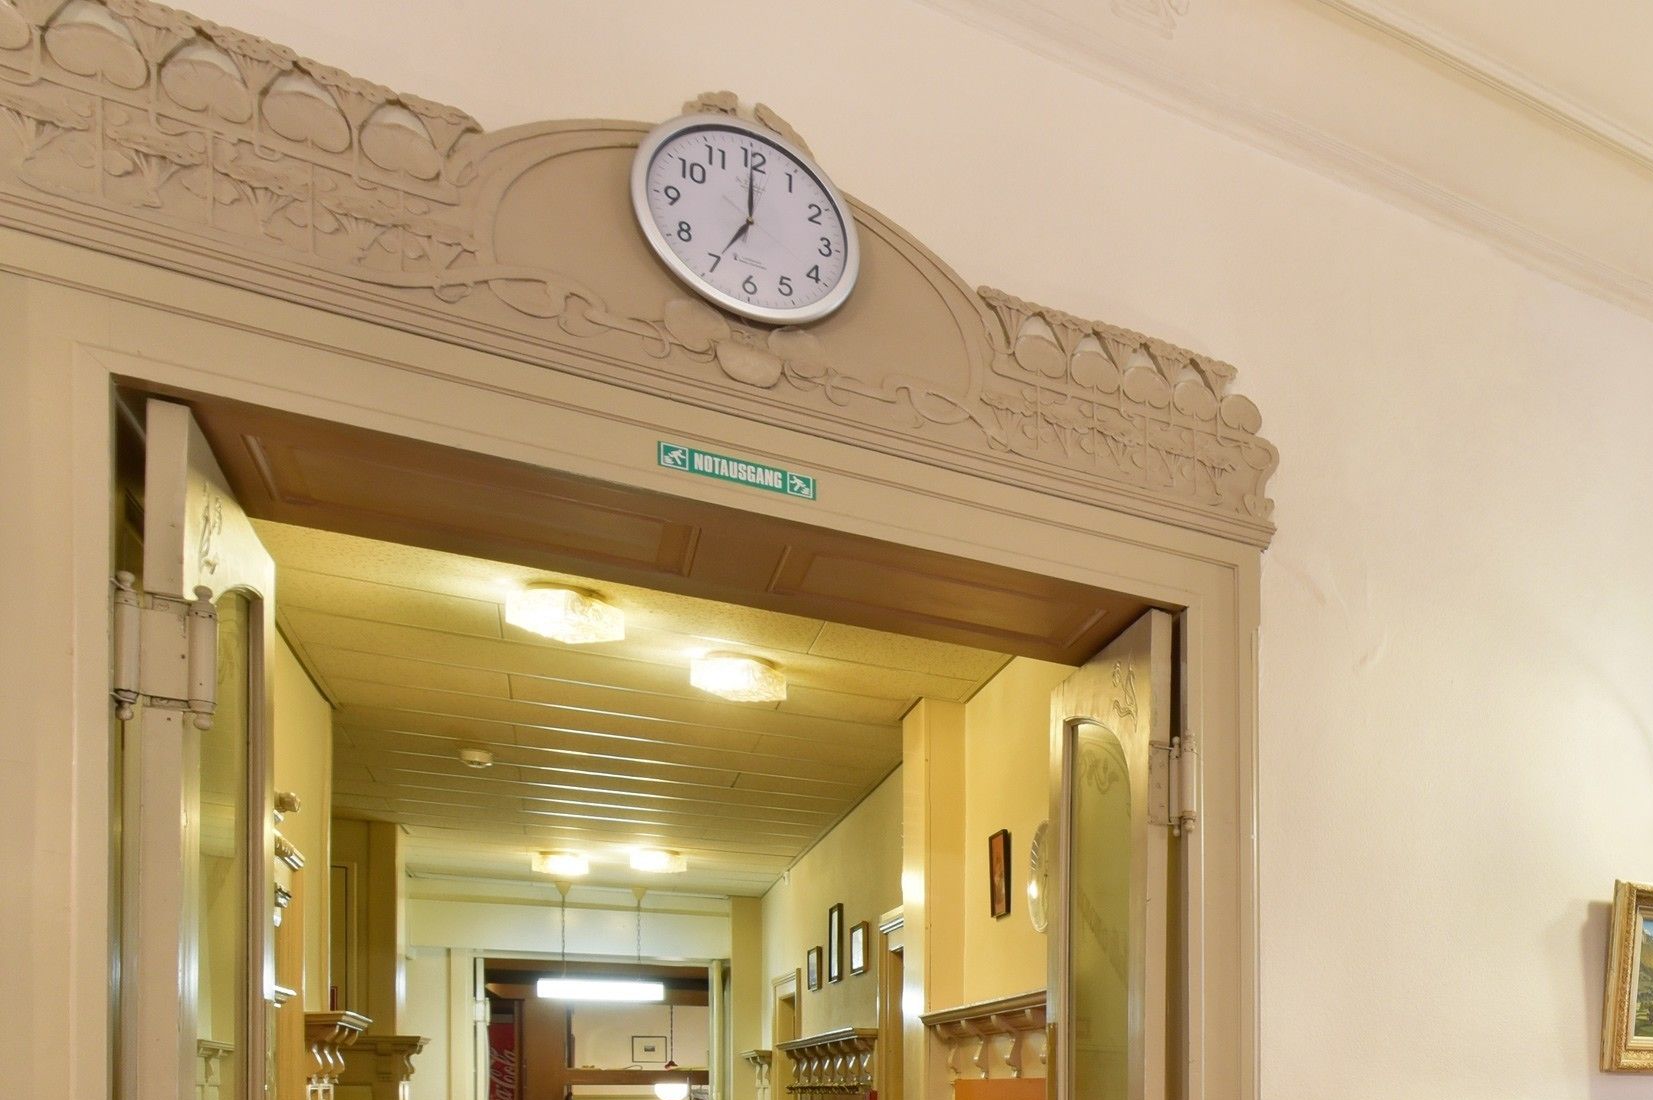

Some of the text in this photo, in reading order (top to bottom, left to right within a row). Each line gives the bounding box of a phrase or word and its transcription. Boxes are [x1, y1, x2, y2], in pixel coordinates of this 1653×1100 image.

[704, 144, 726, 170] 11
[740, 146, 767, 175] 12
[678, 156, 707, 185] 10
[784, 172, 793, 194] 1
[663, 185, 681, 206] 9
[807, 203, 822, 226] 2
[676, 220, 693, 243] 8
[817, 237, 833, 258] 3
[707, 252, 722, 273] 7
[741, 274, 758, 296] 6
[805, 264, 822, 284] 4
[777, 275, 794, 297] 5
[693, 452, 783, 490] NOTAUSGANG
